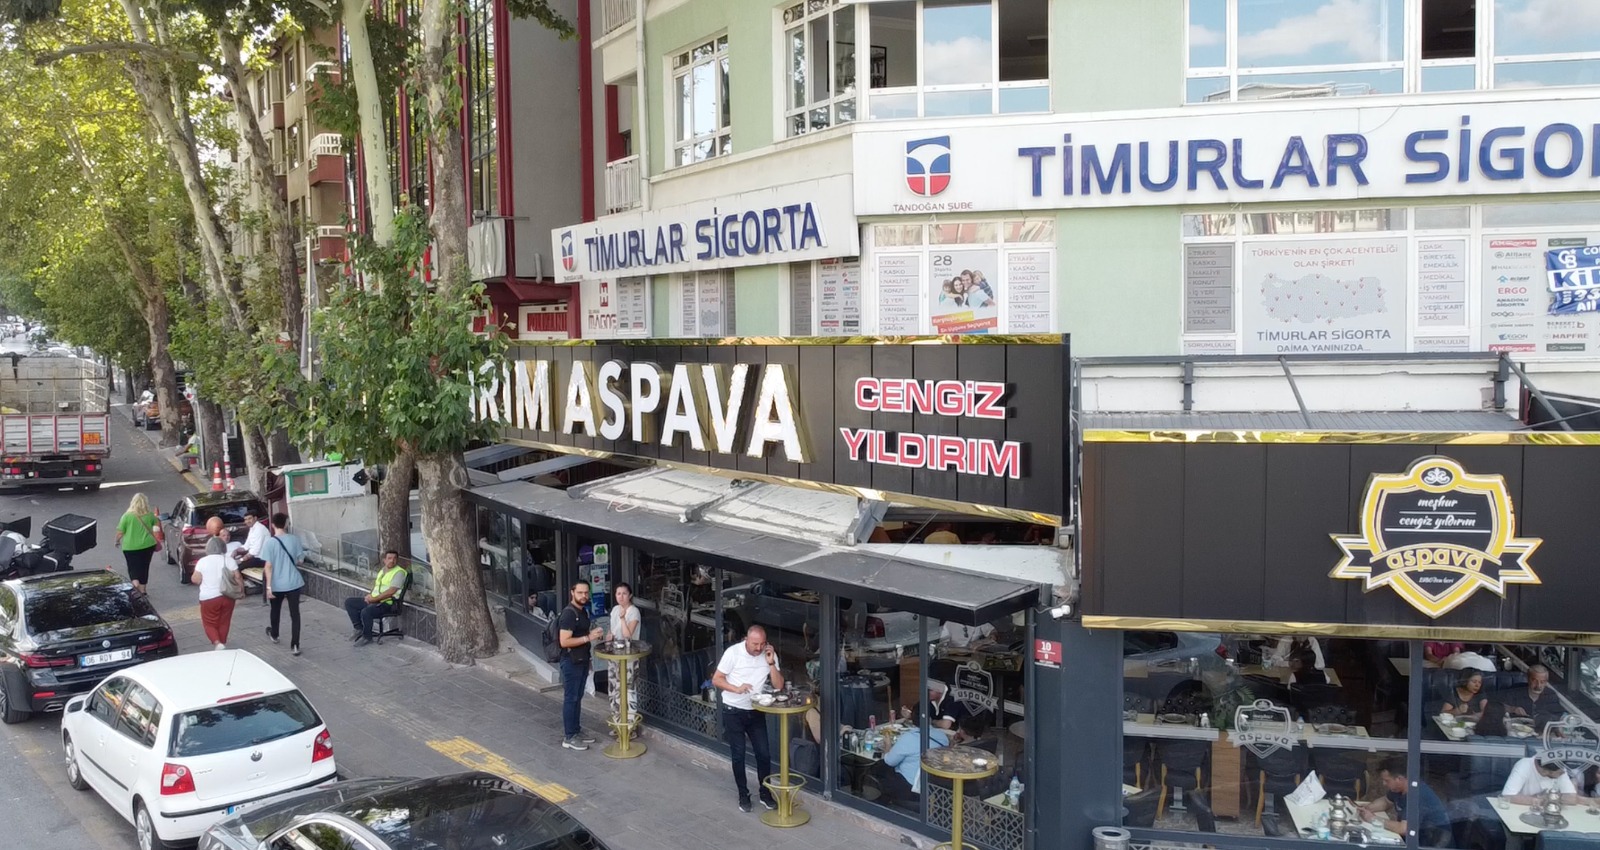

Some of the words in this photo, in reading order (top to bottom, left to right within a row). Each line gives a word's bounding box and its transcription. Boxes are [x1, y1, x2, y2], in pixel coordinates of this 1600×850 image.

[1018, 133, 1369, 197] TİMURLAR
[893, 202, 945, 212] TANDOĞAN
[584, 223, 685, 272] TİMURLAR
[695, 202, 823, 261] SİGORTA
[1252, 248, 1307, 257] TÜRKİYE'NİN
[1323, 248, 1342, 256] ÇOK
[1345, 244, 1398, 254] ACENTELİĞİ
[933, 255, 952, 266] 28
[1321, 258, 1355, 268] ŞİRKETİ
[1257, 330, 1327, 341] TİMURLAR
[1331, 328, 1391, 340] SİGORTA
[1277, 343, 1309, 352] DAİMA
[563, 359, 805, 463] ASPAVA
[840, 428, 1020, 479] YILDIRIM
[1417, 495, 1458, 511] meşhur
[1399, 515, 1432, 530] cengiz
[1434, 514, 1476, 530] yıldırım
[1386, 548, 1484, 572] aspava
[1041, 641, 1052, 651] 10
[86, 656, 96, 665] 06
[1239, 734, 1289, 745] aspava
